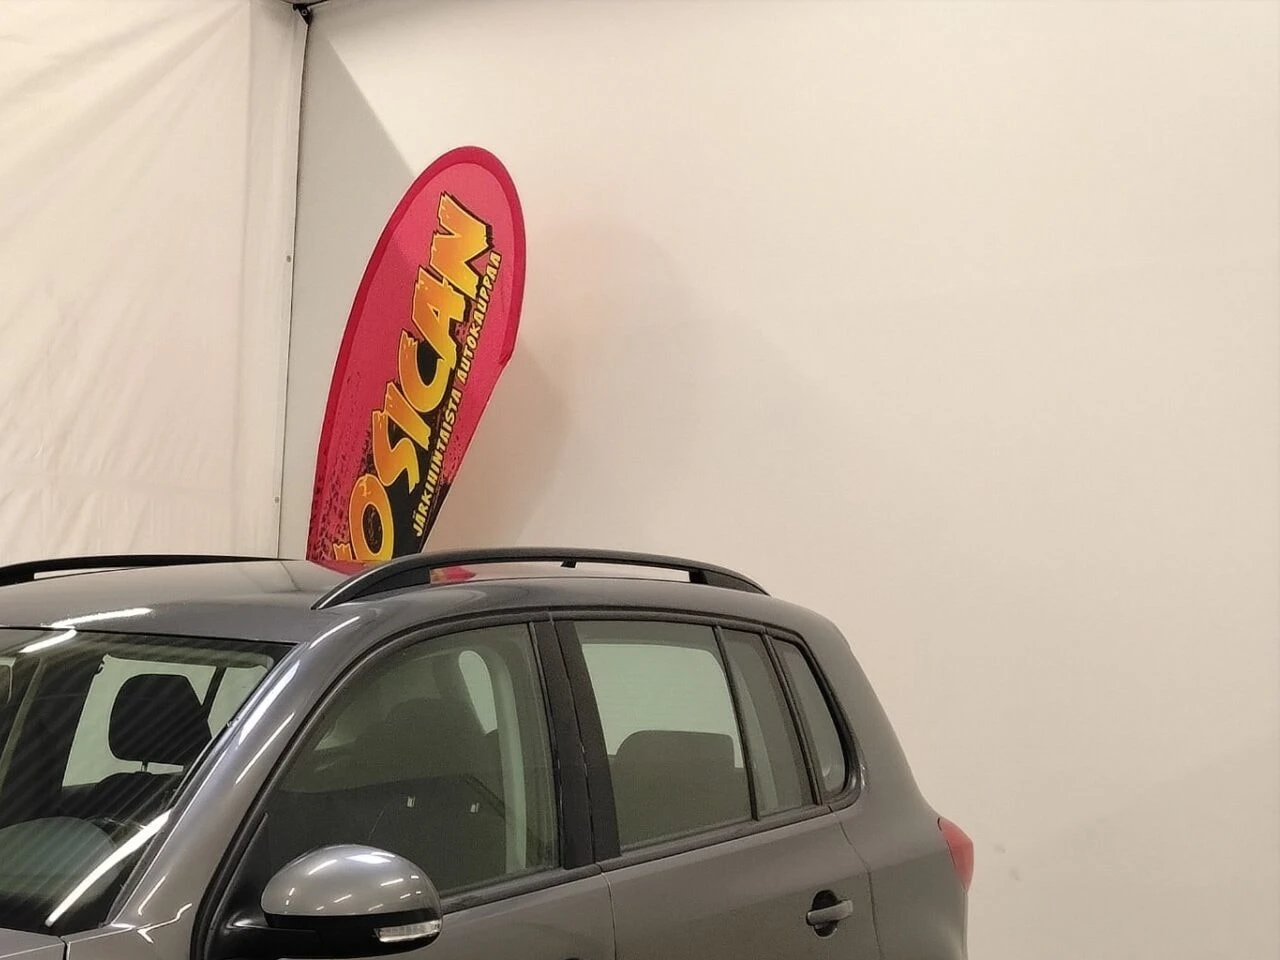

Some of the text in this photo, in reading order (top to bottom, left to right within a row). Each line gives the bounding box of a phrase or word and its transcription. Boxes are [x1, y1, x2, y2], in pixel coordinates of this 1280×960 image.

[332, 190, 489, 561] OSICAN
[412, 250, 502, 537] JÄRKIHINTAISTA AUTOKAUPPAA
